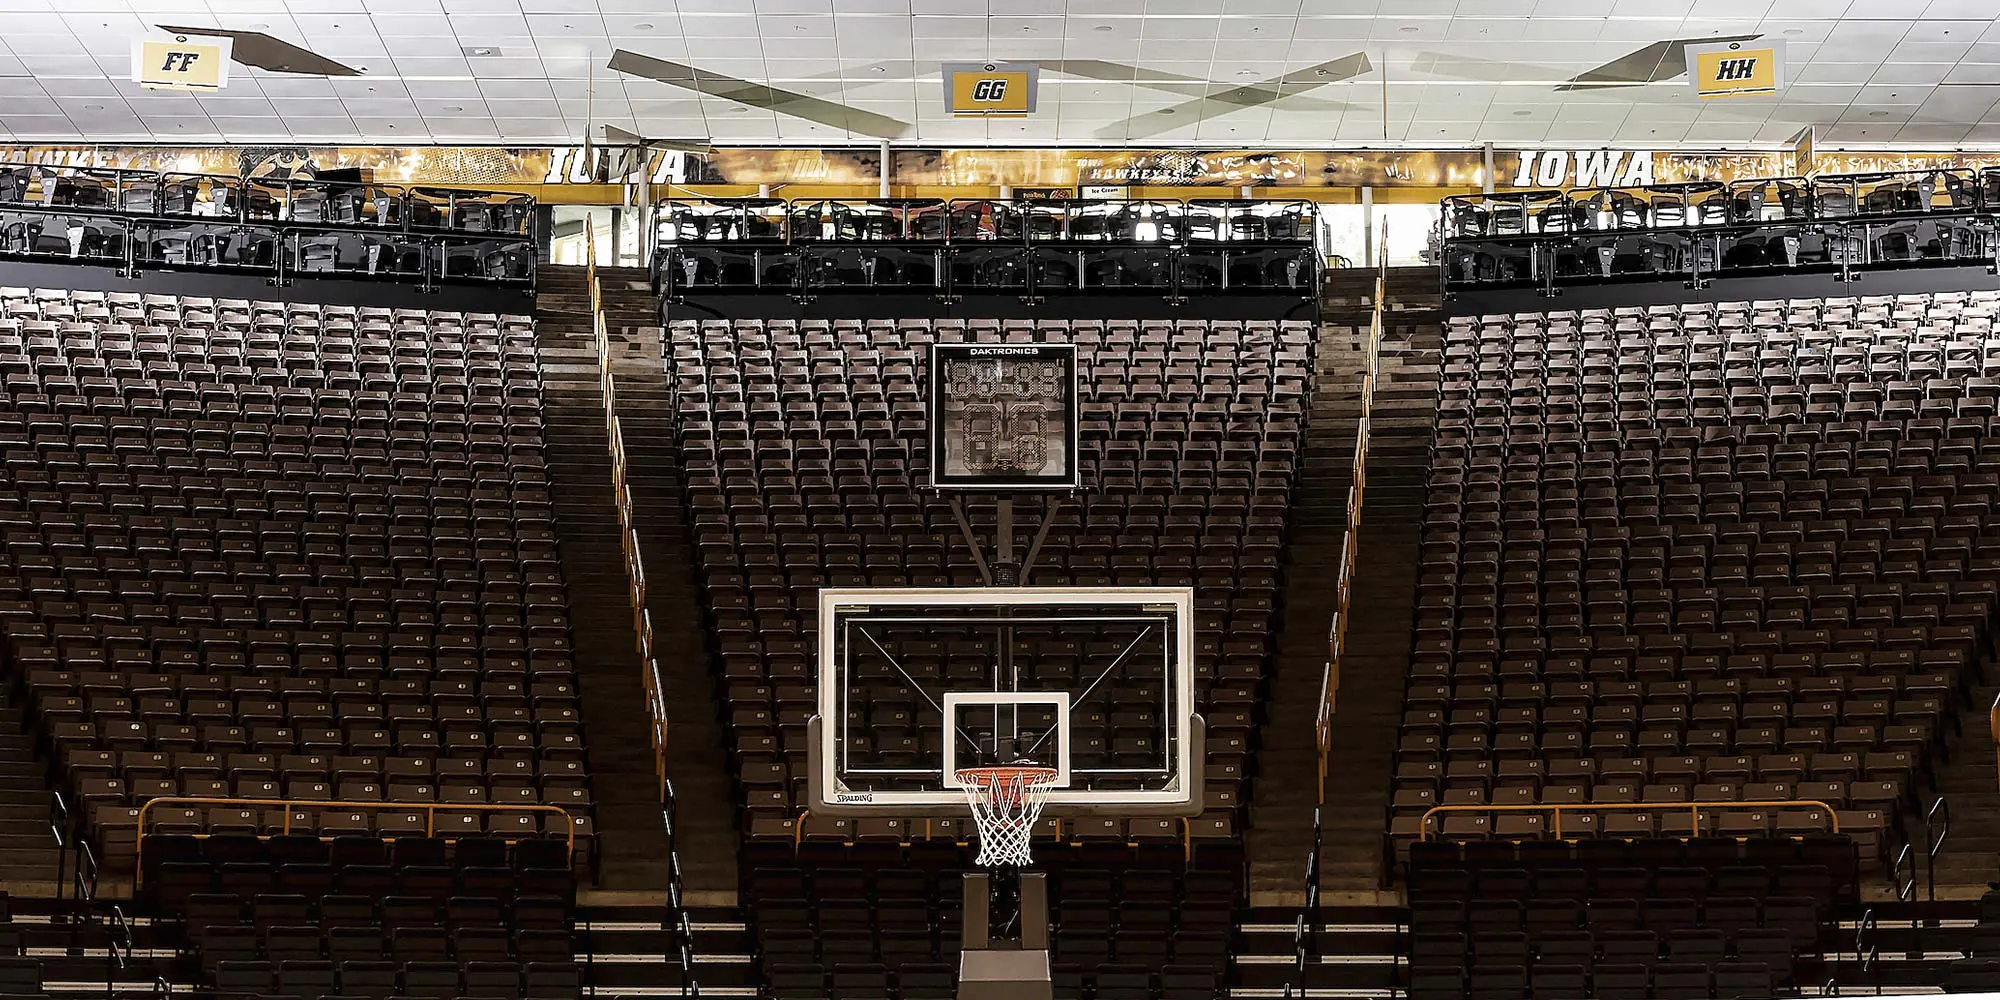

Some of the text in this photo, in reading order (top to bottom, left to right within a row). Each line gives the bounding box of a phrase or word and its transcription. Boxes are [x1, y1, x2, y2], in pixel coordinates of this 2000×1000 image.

[161, 52, 199, 72] FF
[1716, 59, 1757, 80] HH
[973, 80, 1008, 101] GG
[544, 148, 687, 184] IOWA
[1513, 151, 1655, 187] IOWA
[970, 348, 1039, 356] DAKTRONICS
[837, 794, 872, 802] SPALDING
